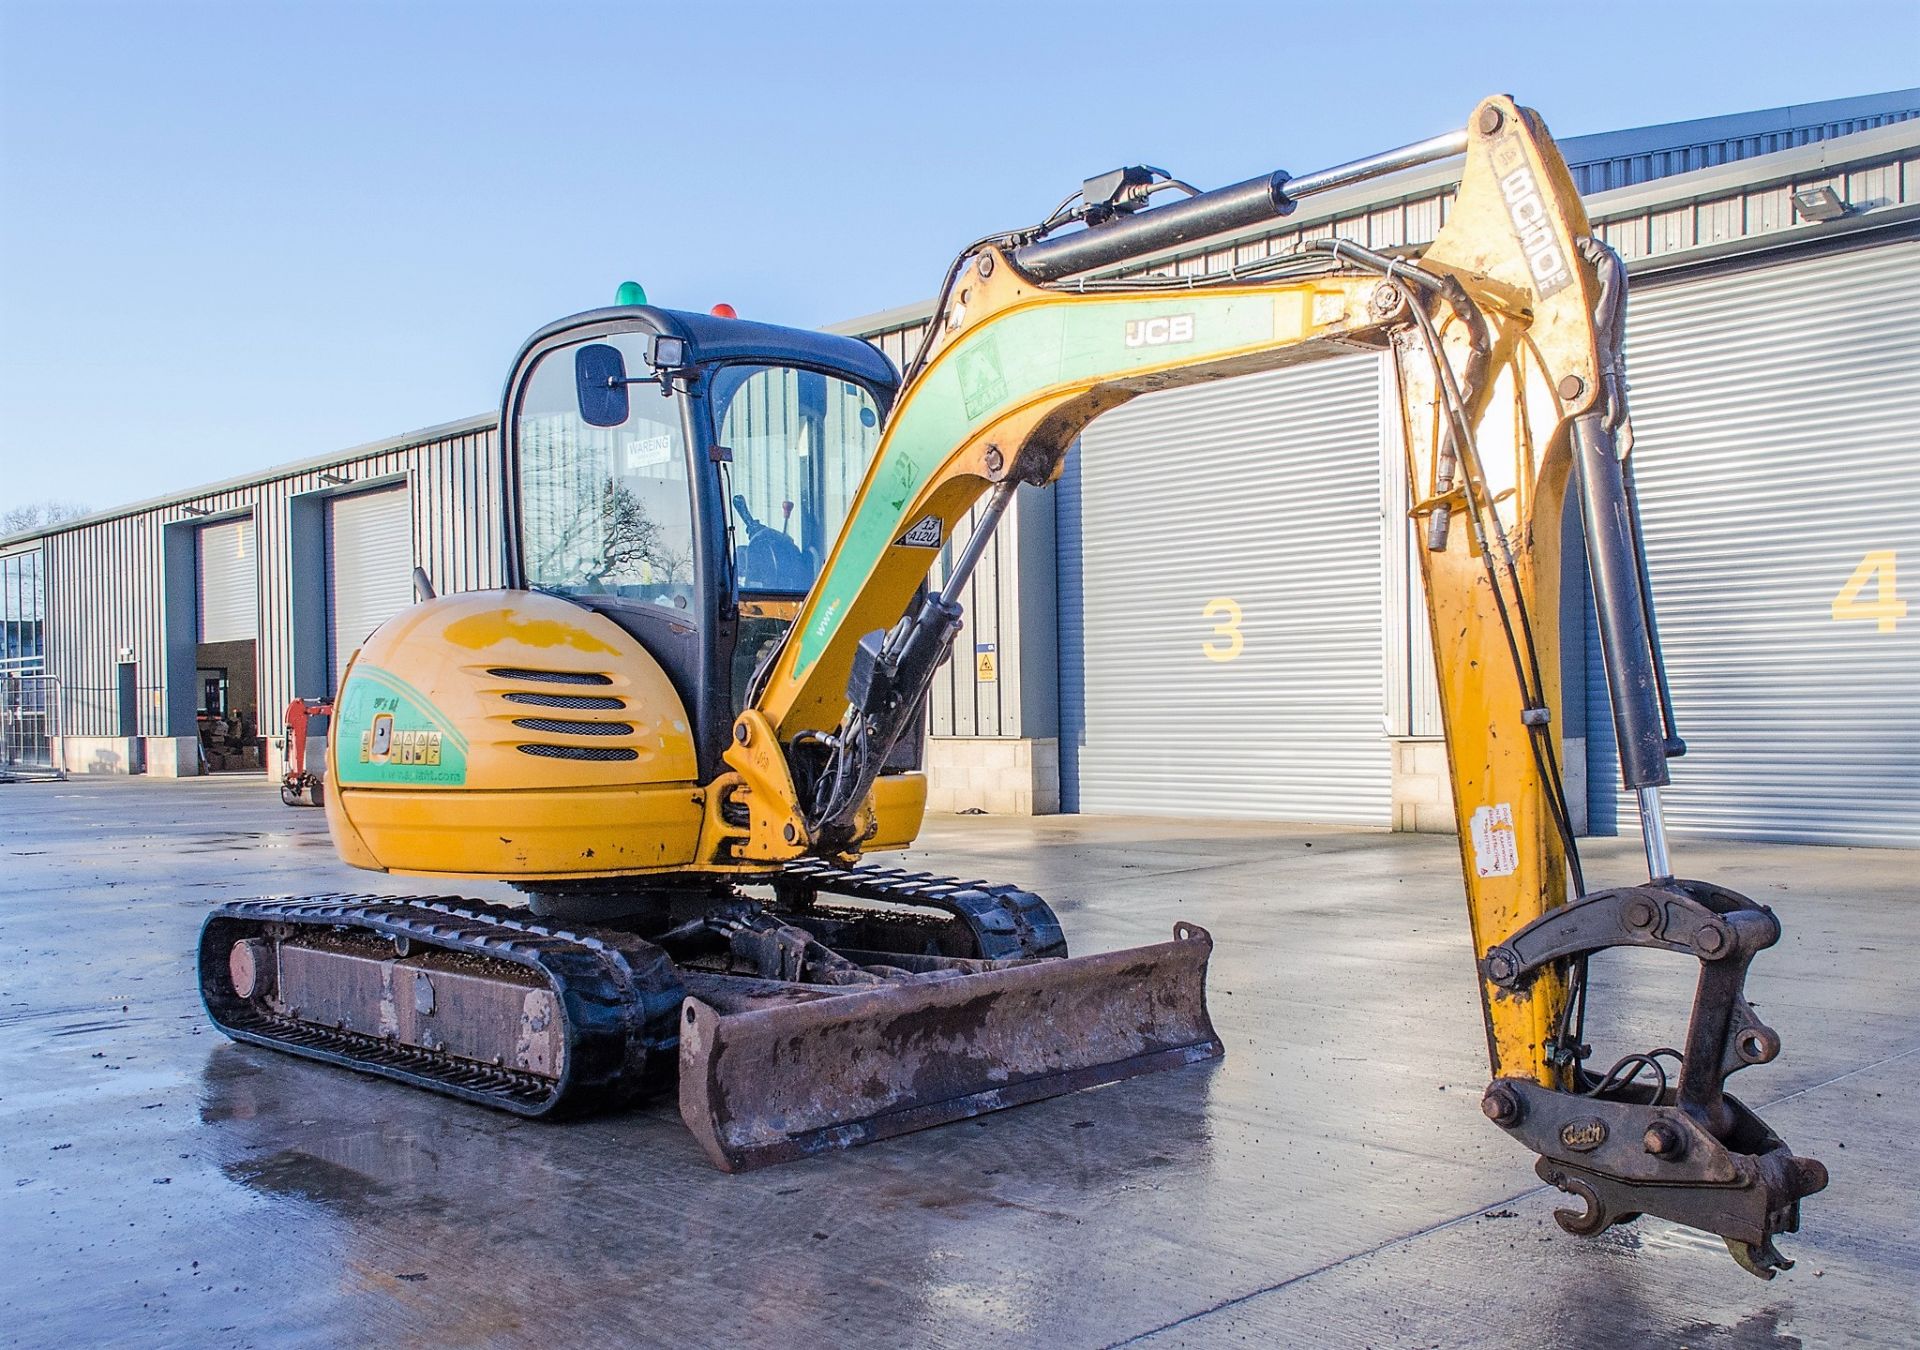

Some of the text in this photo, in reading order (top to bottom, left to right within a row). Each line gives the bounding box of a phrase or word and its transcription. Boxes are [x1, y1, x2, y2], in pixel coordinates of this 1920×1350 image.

[1502, 166, 1563, 282] 8050
[1538, 269, 1568, 292] RTS
[1125, 314, 1194, 348] JCB
[921, 520, 938, 531] 13
[1832, 550, 1907, 633] 4
[1202, 597, 1245, 662] 3
